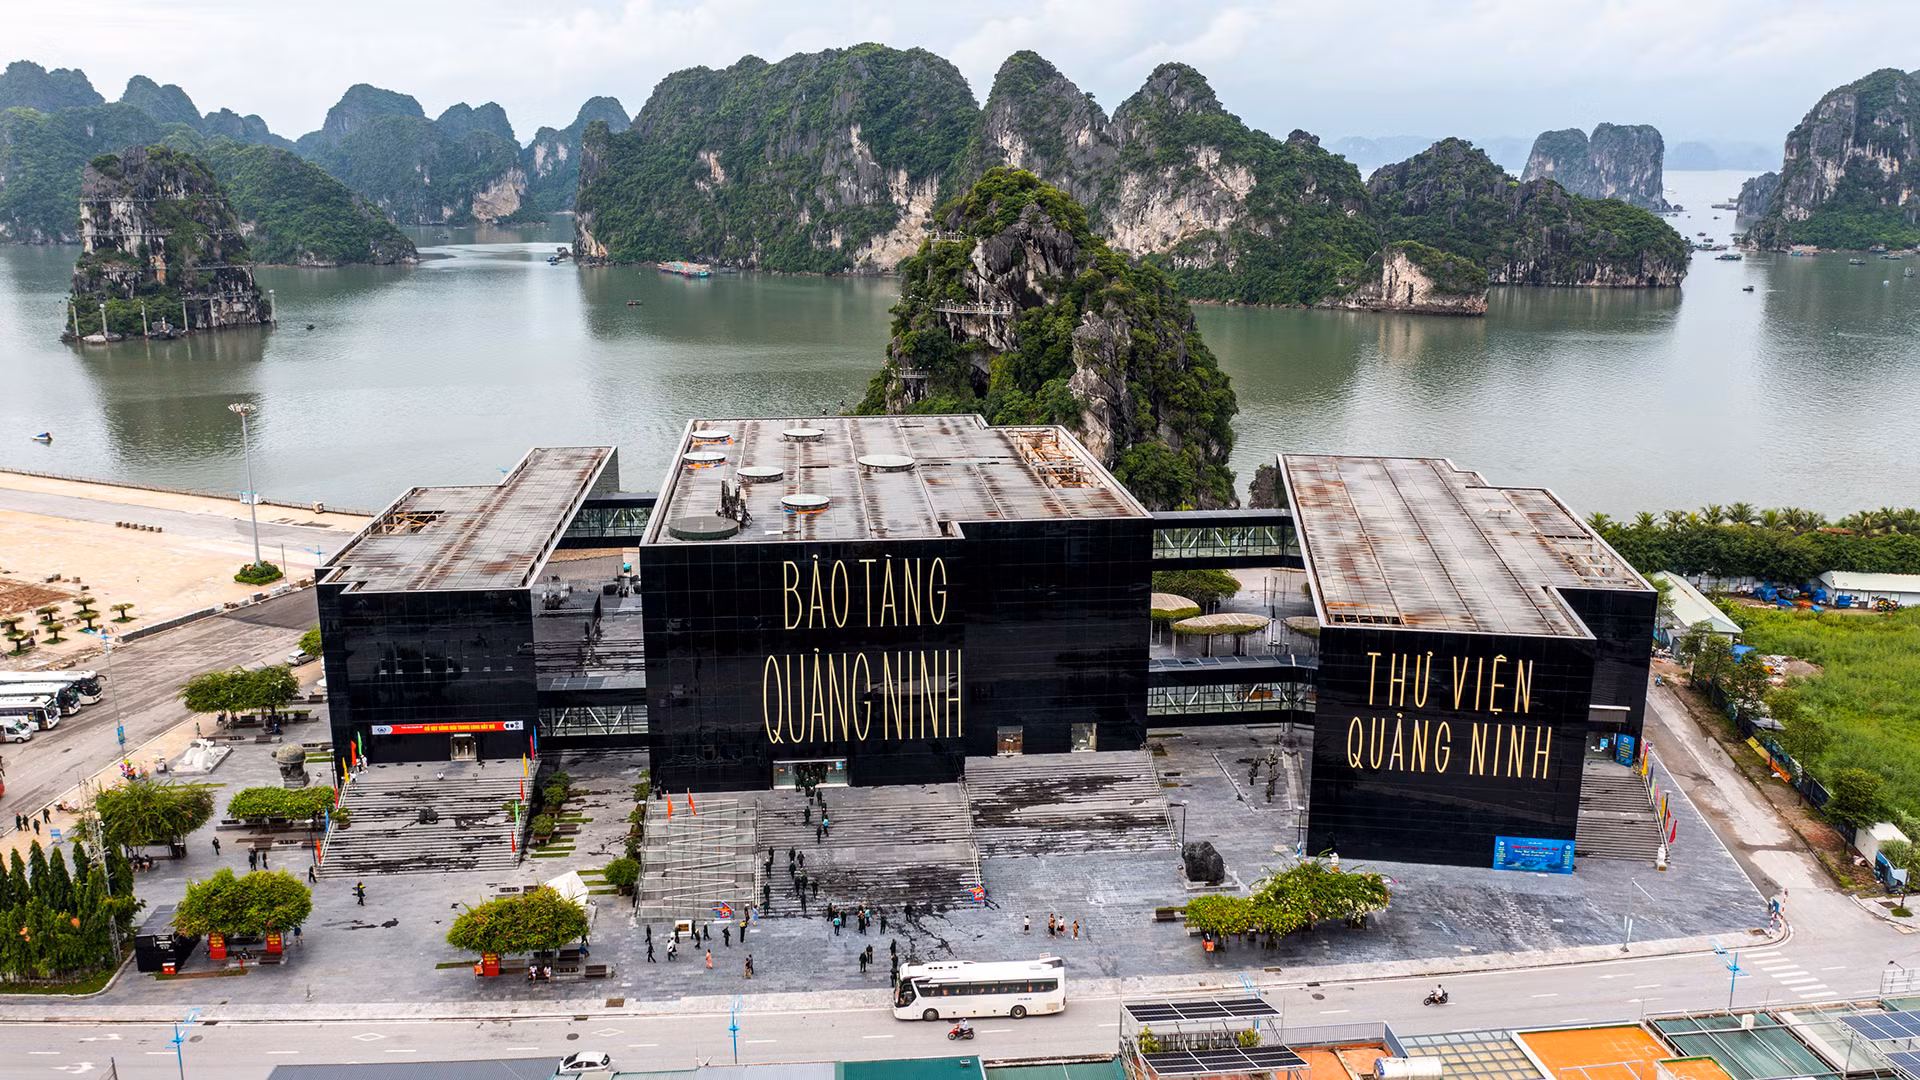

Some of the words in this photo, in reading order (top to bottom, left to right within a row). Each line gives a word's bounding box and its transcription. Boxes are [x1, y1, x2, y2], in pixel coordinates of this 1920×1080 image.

[783, 554, 849, 630] BẢO
[858, 554, 947, 627] TÀNG
[763, 647, 871, 744] QUẢNG
[883, 648, 962, 741] NINH
[1367, 651, 1433, 708] THƯ
[1453, 654, 1533, 715] VIỆN
[1347, 712, 1451, 774] QUẢNG
[1469, 722, 1552, 780] NINH
